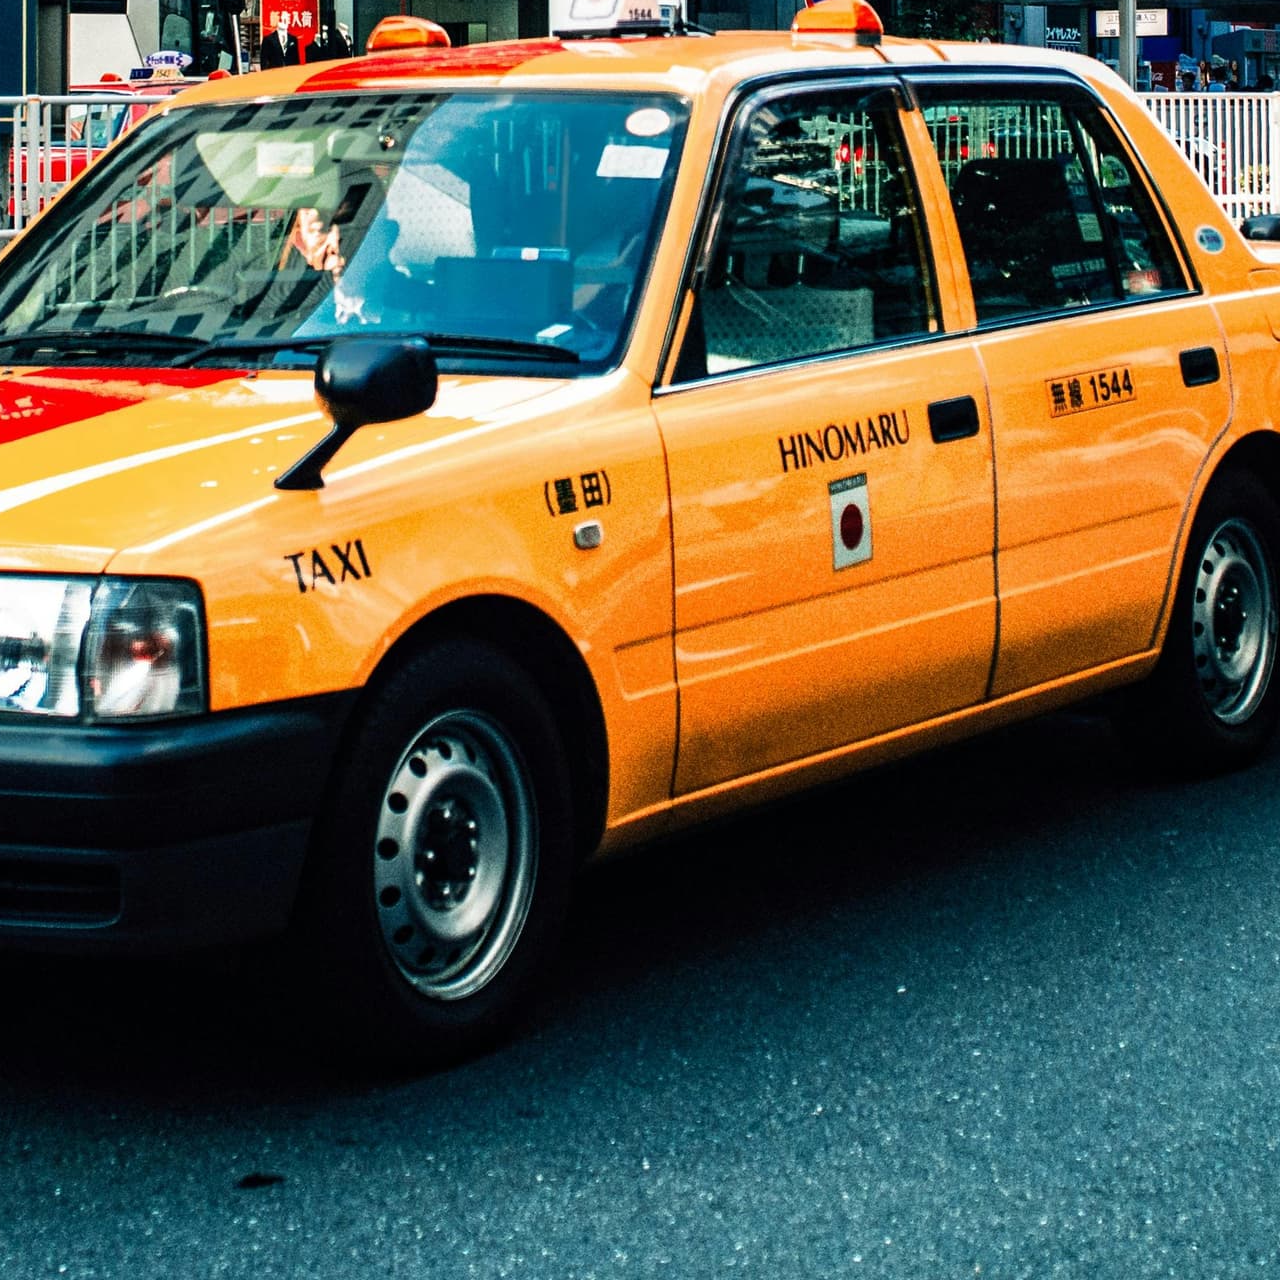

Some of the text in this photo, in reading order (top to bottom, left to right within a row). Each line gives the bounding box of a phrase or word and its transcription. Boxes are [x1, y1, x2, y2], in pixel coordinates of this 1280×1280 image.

[1090, 368, 1133, 404] 1544
[778, 409, 910, 473] HINOMARU
[283, 539, 372, 593] TAXI
